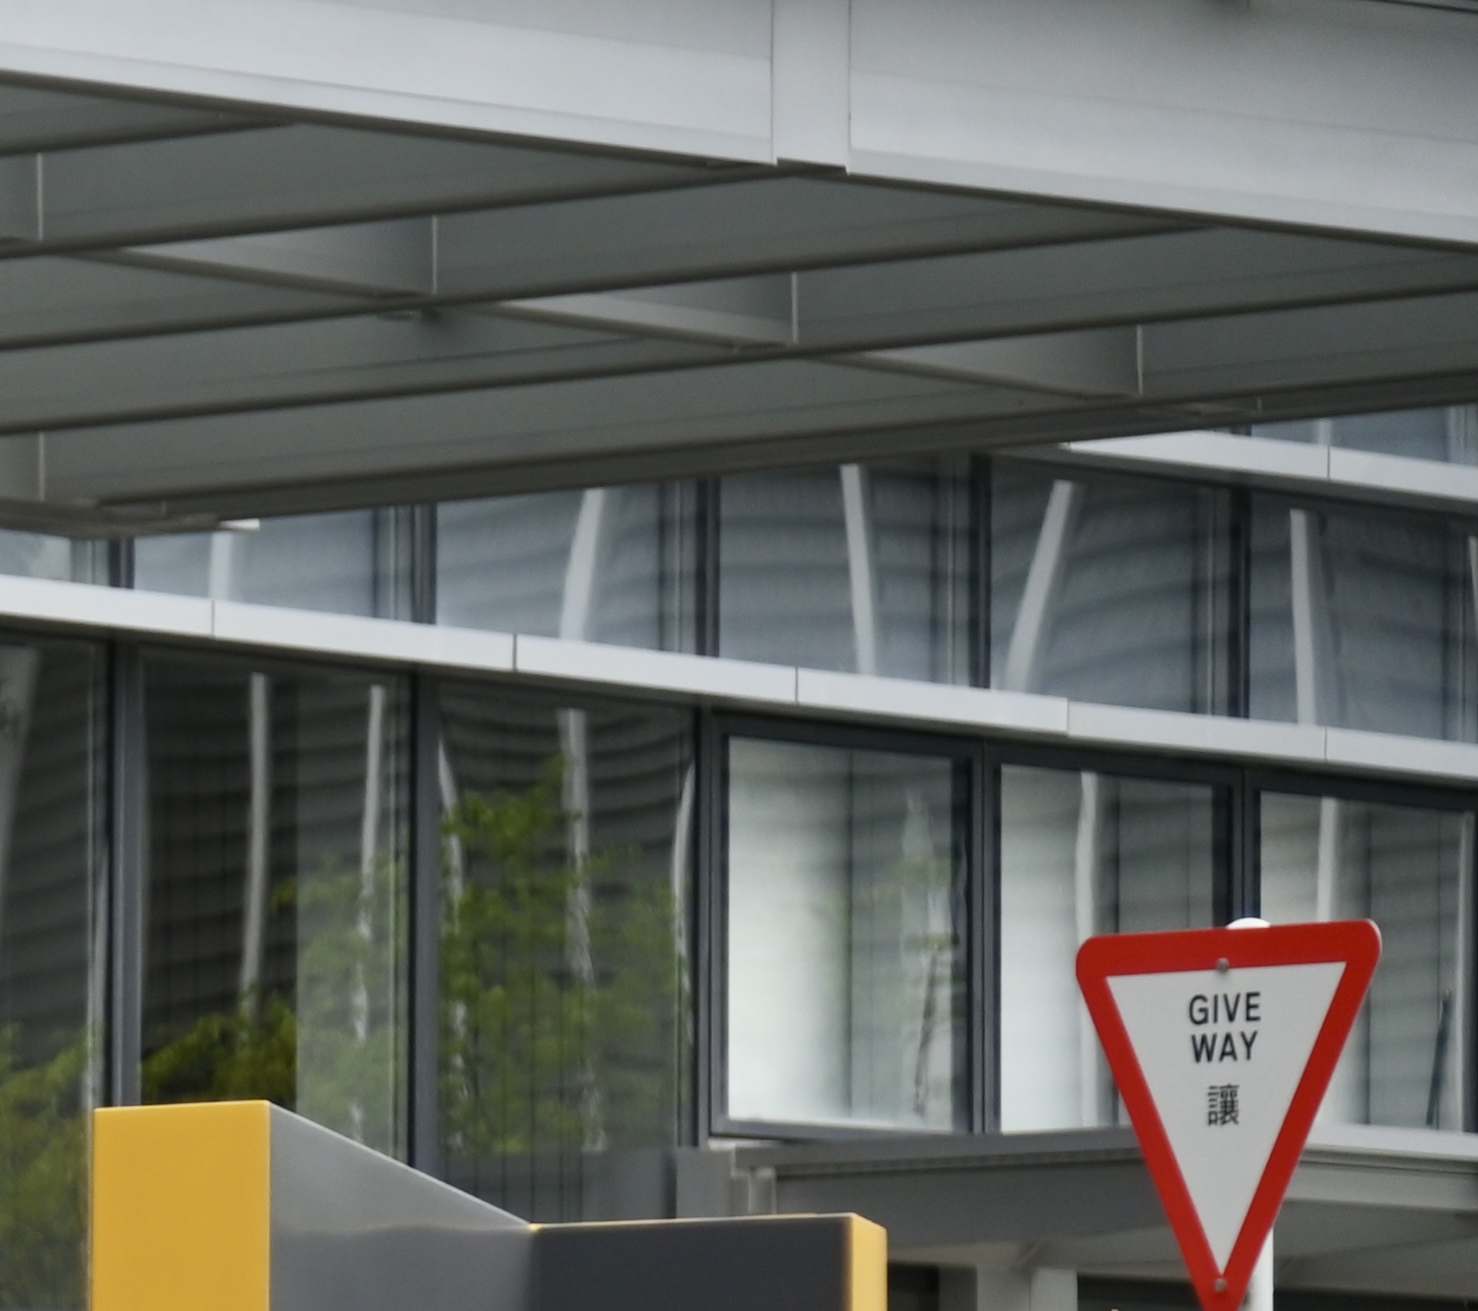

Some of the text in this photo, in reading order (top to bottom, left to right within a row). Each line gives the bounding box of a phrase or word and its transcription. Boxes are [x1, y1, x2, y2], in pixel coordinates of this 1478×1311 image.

[1188, 991, 1262, 1026] GIVE
[1190, 1030, 1259, 1064] WAY
[1207, 1084, 1240, 1127] 讓
